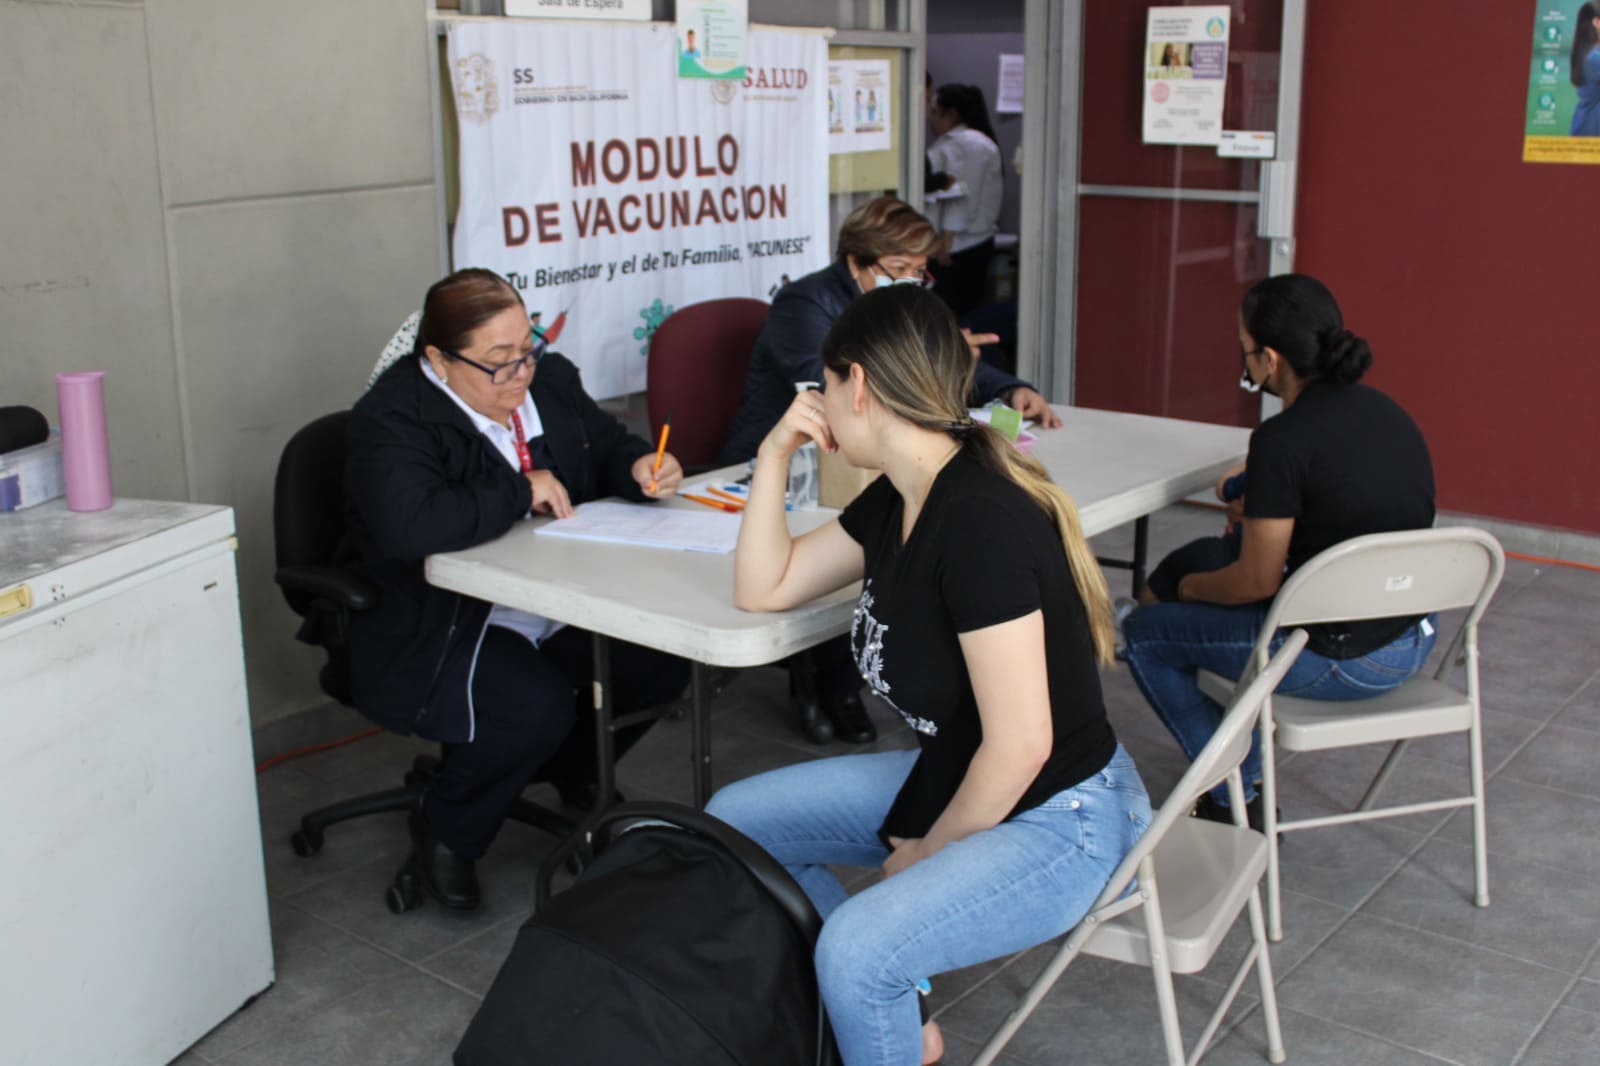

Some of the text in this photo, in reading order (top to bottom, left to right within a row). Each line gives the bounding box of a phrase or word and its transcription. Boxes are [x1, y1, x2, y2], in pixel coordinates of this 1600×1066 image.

[513, 68, 534, 84] SS
[742, 66, 808, 89] SALUD
[570, 134, 739, 187] MODULO
[502, 184, 787, 247] DE VACUNACION
[534, 263, 603, 288] Bienestar
[606, 261, 617, 283] y
[621, 254, 637, 275] el
[641, 252, 660, 273] de
[662, 251, 680, 270] Tu
[681, 243, 743, 267] Familia,
